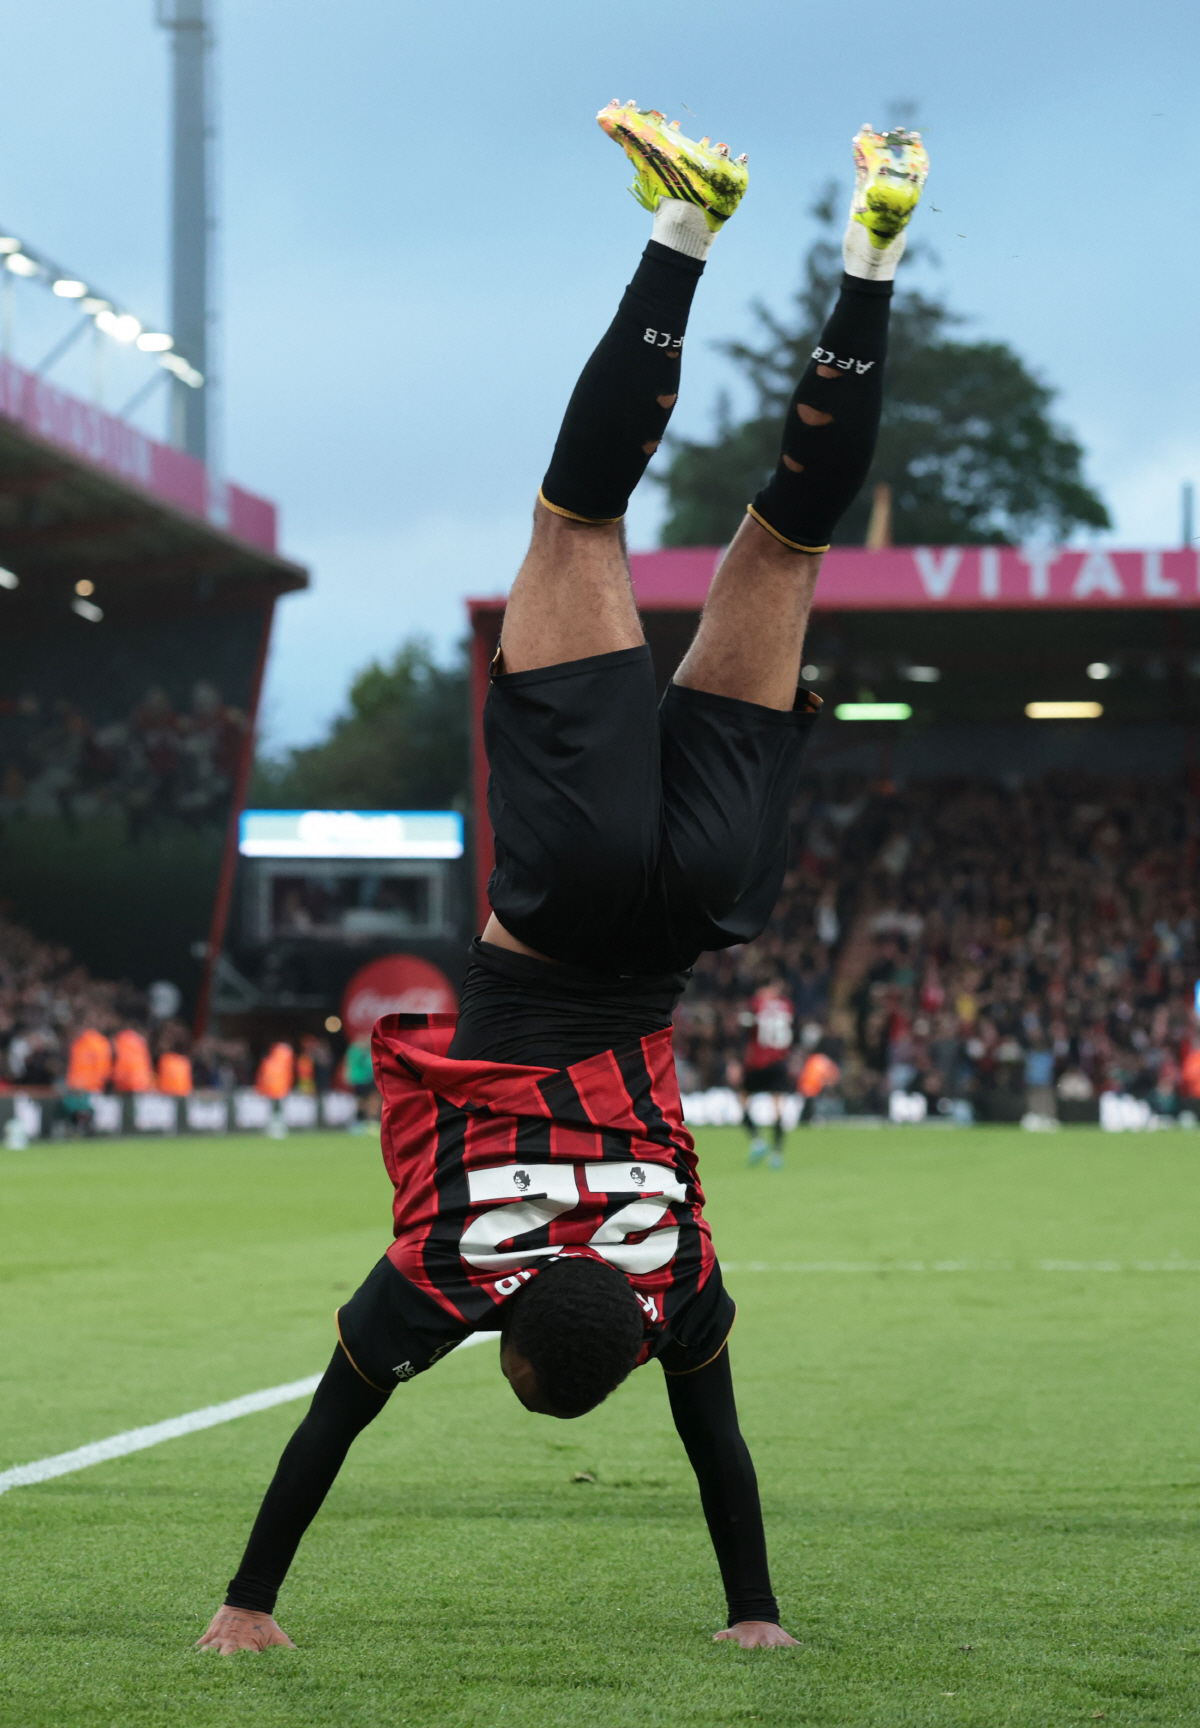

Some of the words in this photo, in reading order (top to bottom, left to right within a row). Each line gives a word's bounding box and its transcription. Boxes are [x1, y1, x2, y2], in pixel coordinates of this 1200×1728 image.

[811, 346, 875, 375] AFCB
[912, 546, 1200, 600] VITAL
[458, 1161, 687, 1275] 22
